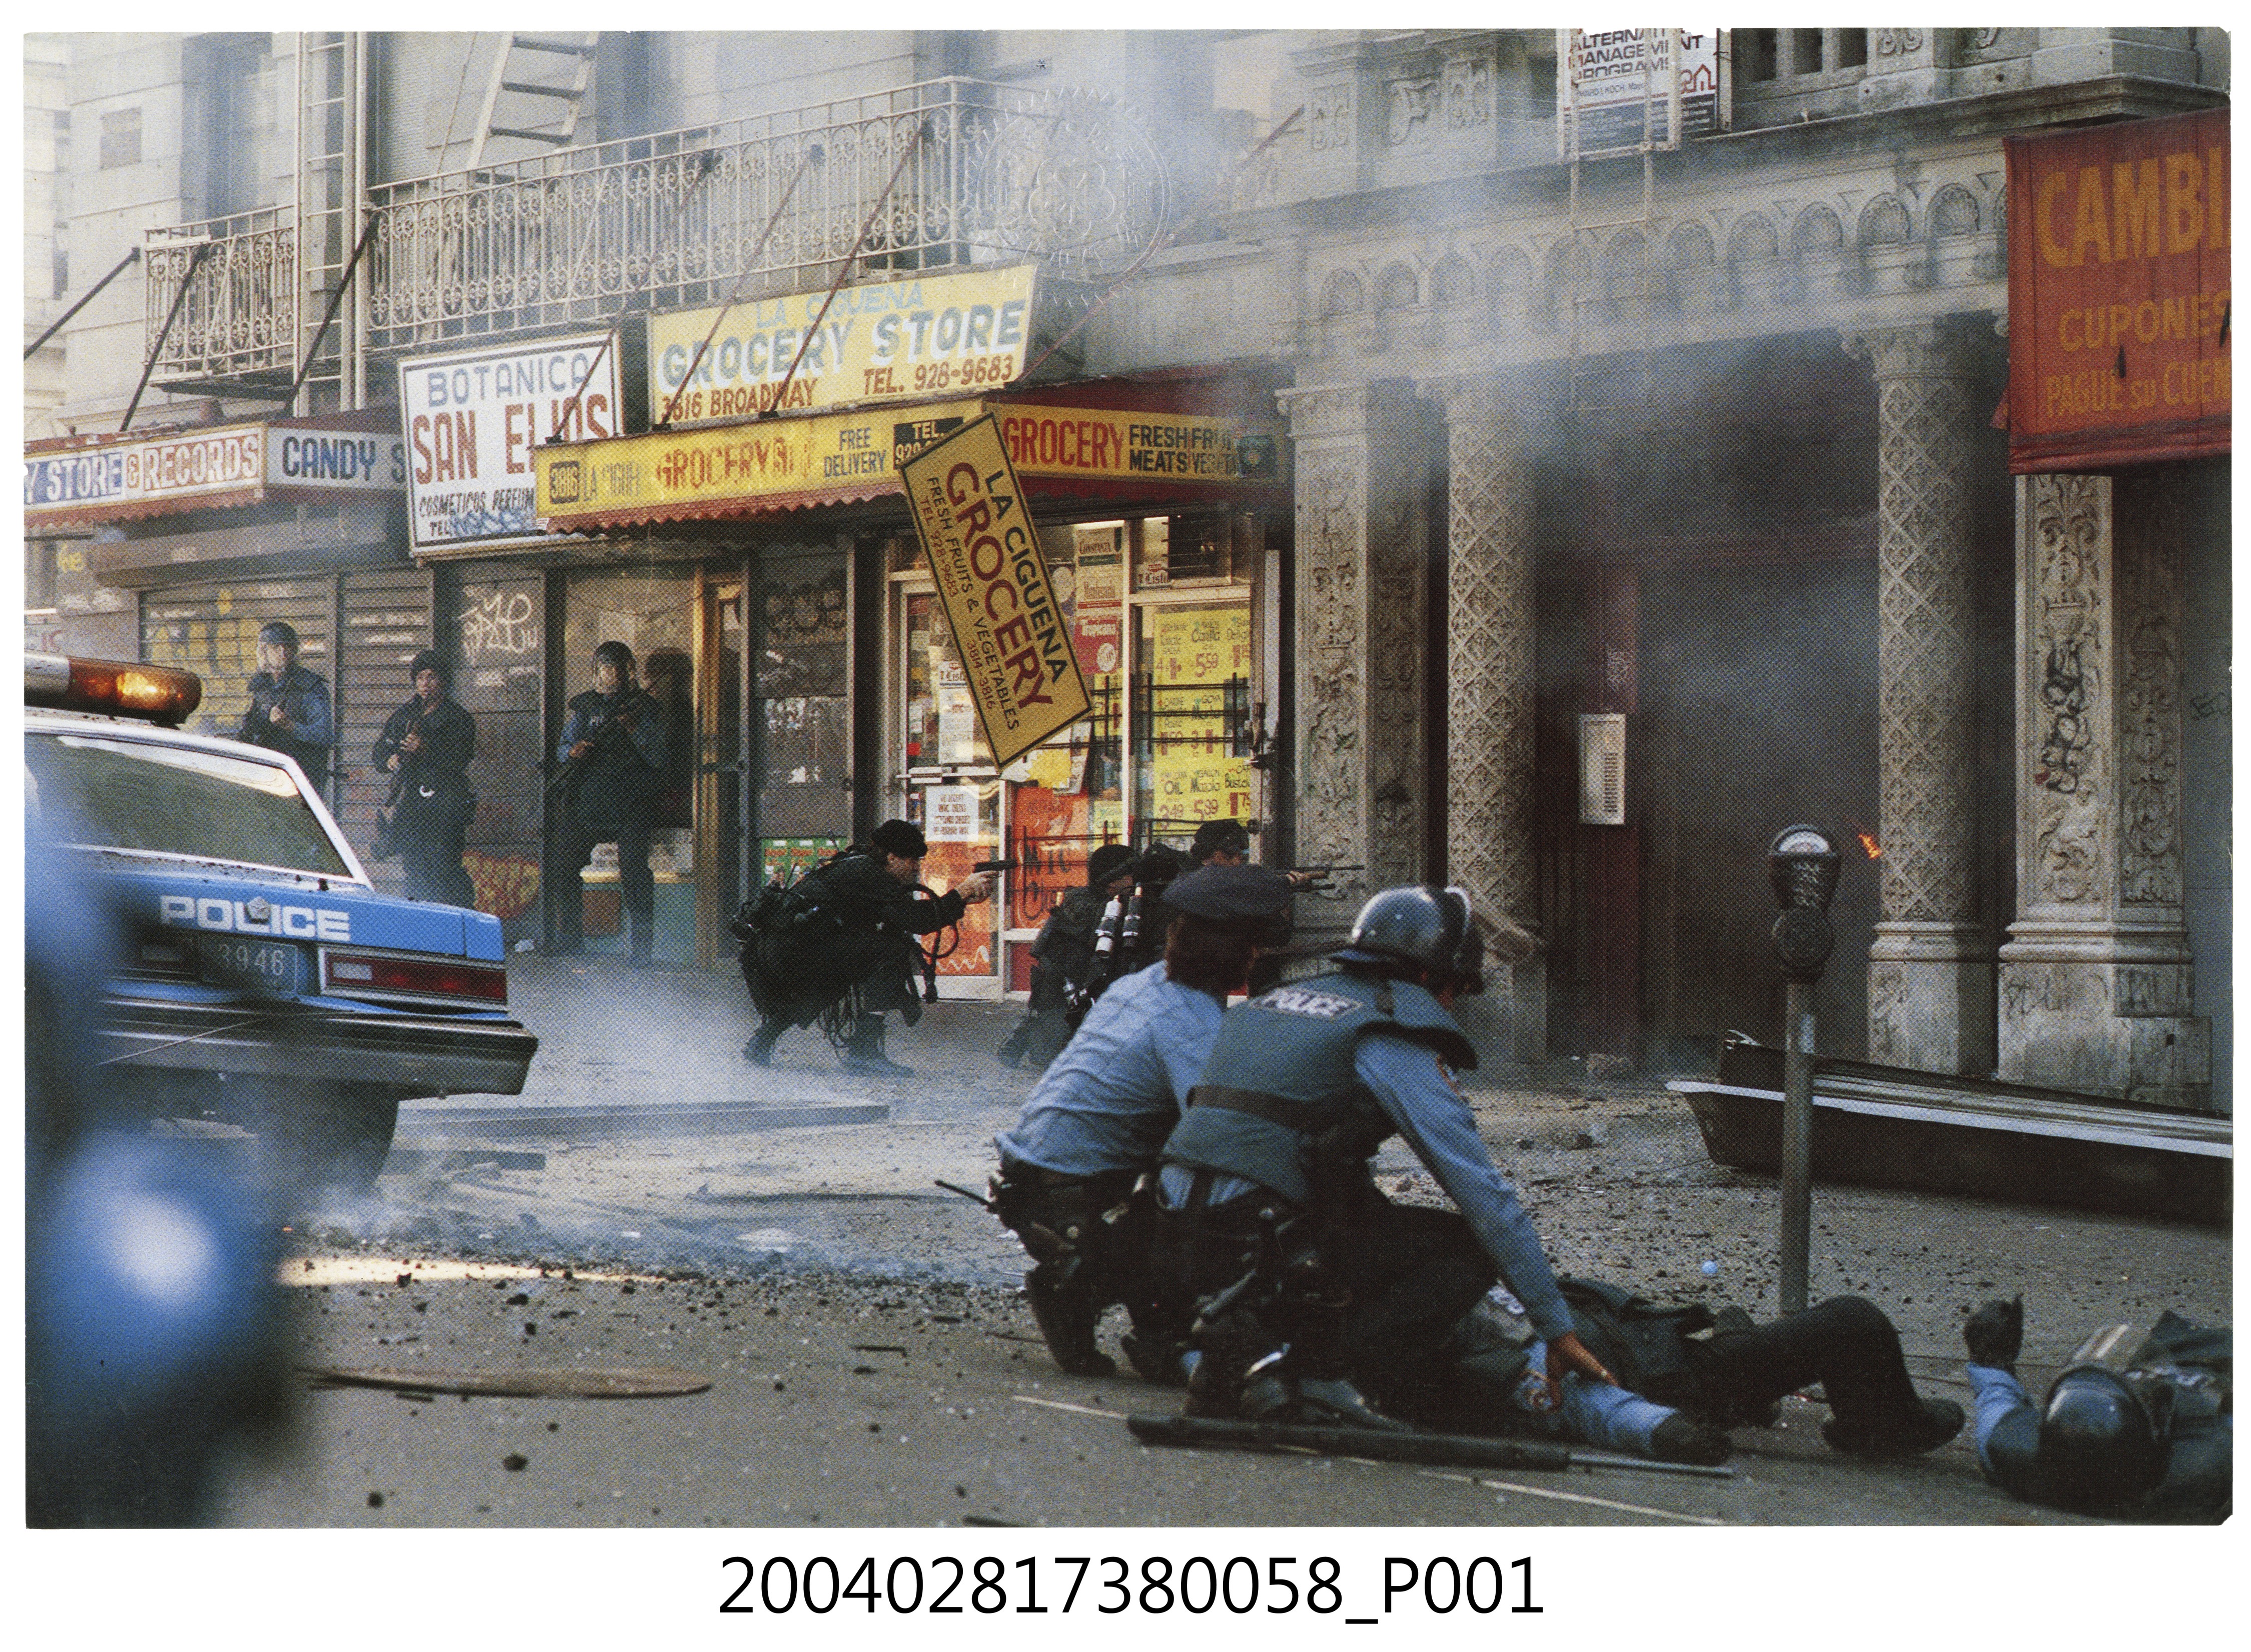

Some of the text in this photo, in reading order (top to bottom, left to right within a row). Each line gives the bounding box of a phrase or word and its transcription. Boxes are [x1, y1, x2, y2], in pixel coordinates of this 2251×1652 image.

[756, 300, 787, 329] LA
[657, 299, 1026, 394] GROCERY STORE
[428, 353, 590, 408] BOTANICA
[709, 378, 818, 417] BROADWAY
[863, 367, 904, 395] TEL.
[914, 354, 1013, 391] 928-9683
[412, 410, 478, 485] SAN
[839, 427, 872, 451] FREE
[912, 421, 945, 440] TEL.
[1002, 416, 1124, 471] GROCERY
[1129, 424, 1189, 450] FRESH
[48, 453, 122, 501] STORE
[143, 433, 260, 491] RECORDS
[282, 436, 377, 481] CANDY
[824, 449, 887, 478] DELIVERY
[1129, 449, 1189, 474] MEATS
[926, 477, 952, 529] FRESH
[949, 537, 974, 593] FRUITS
[973, 616, 1019, 730] VEGETABLES
[946, 462, 1053, 709] GROCERY
[984, 469, 1068, 683] LA CIGUENA
[930, 531, 958, 598] 928-9683
[966, 640, 996, 710] 3814-3816
[160, 895, 351, 942] POLICE
[218, 943, 286, 977] 3946
